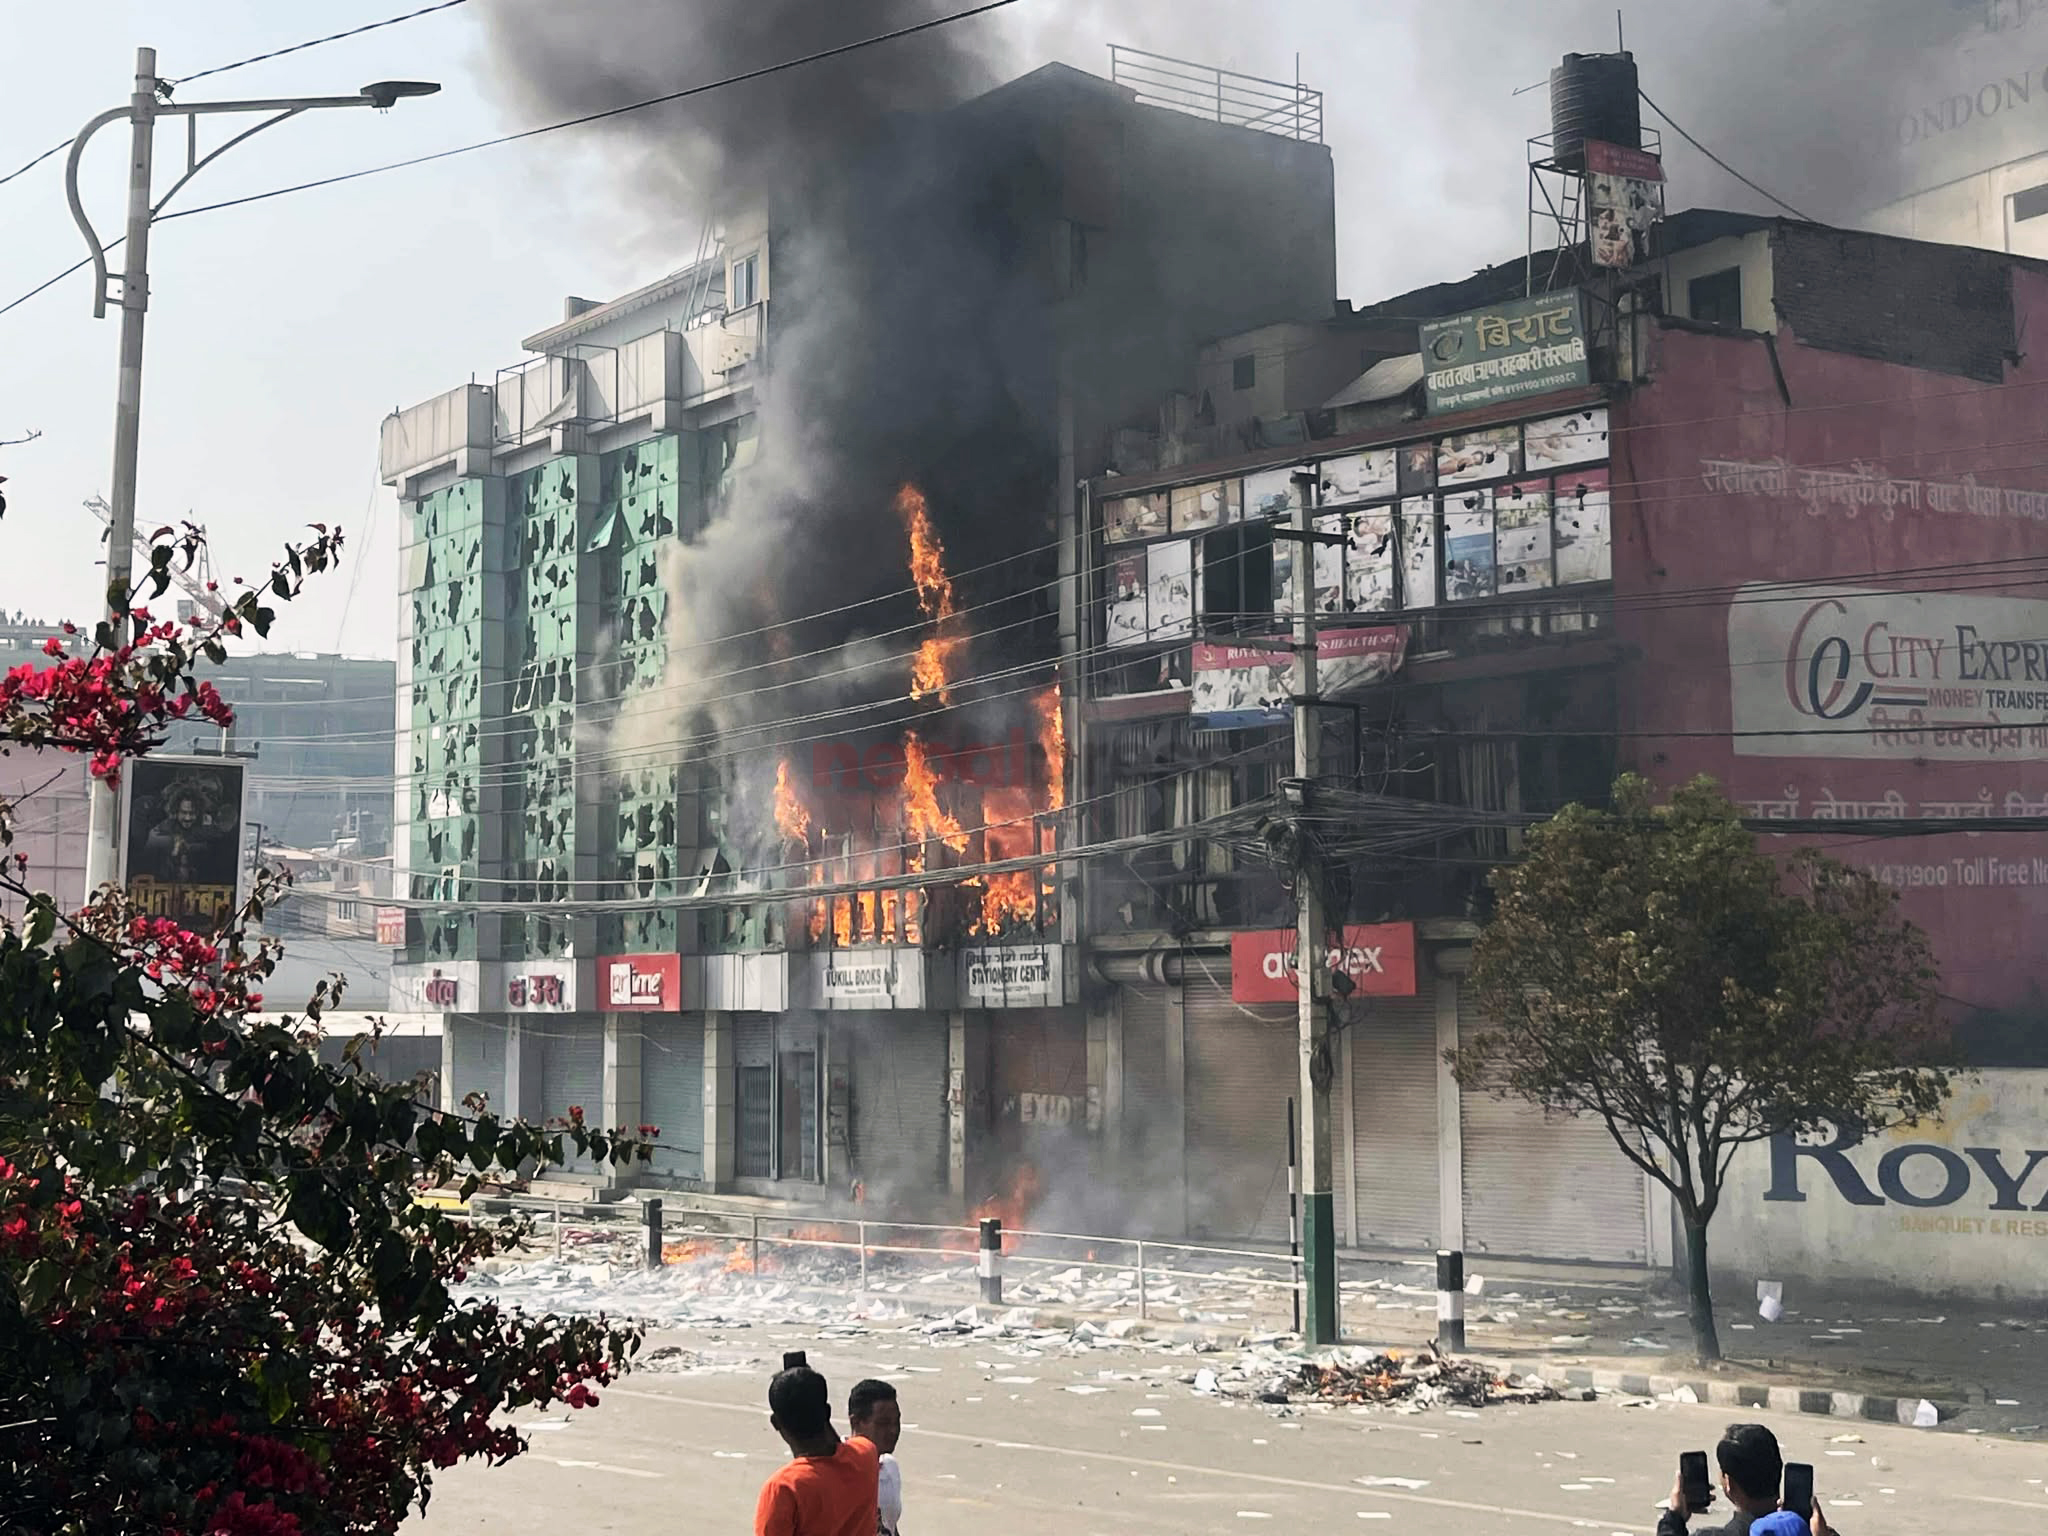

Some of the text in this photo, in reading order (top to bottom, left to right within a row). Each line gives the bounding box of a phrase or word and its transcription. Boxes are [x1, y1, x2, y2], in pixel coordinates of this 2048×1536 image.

[1929, 687, 1984, 709] MONEY
[1952, 858, 1983, 885] Toll
[1989, 858, 2028, 885] Free
[855, 968, 881, 986] BOOKS
[1762, 1105, 2048, 1212] ROY
